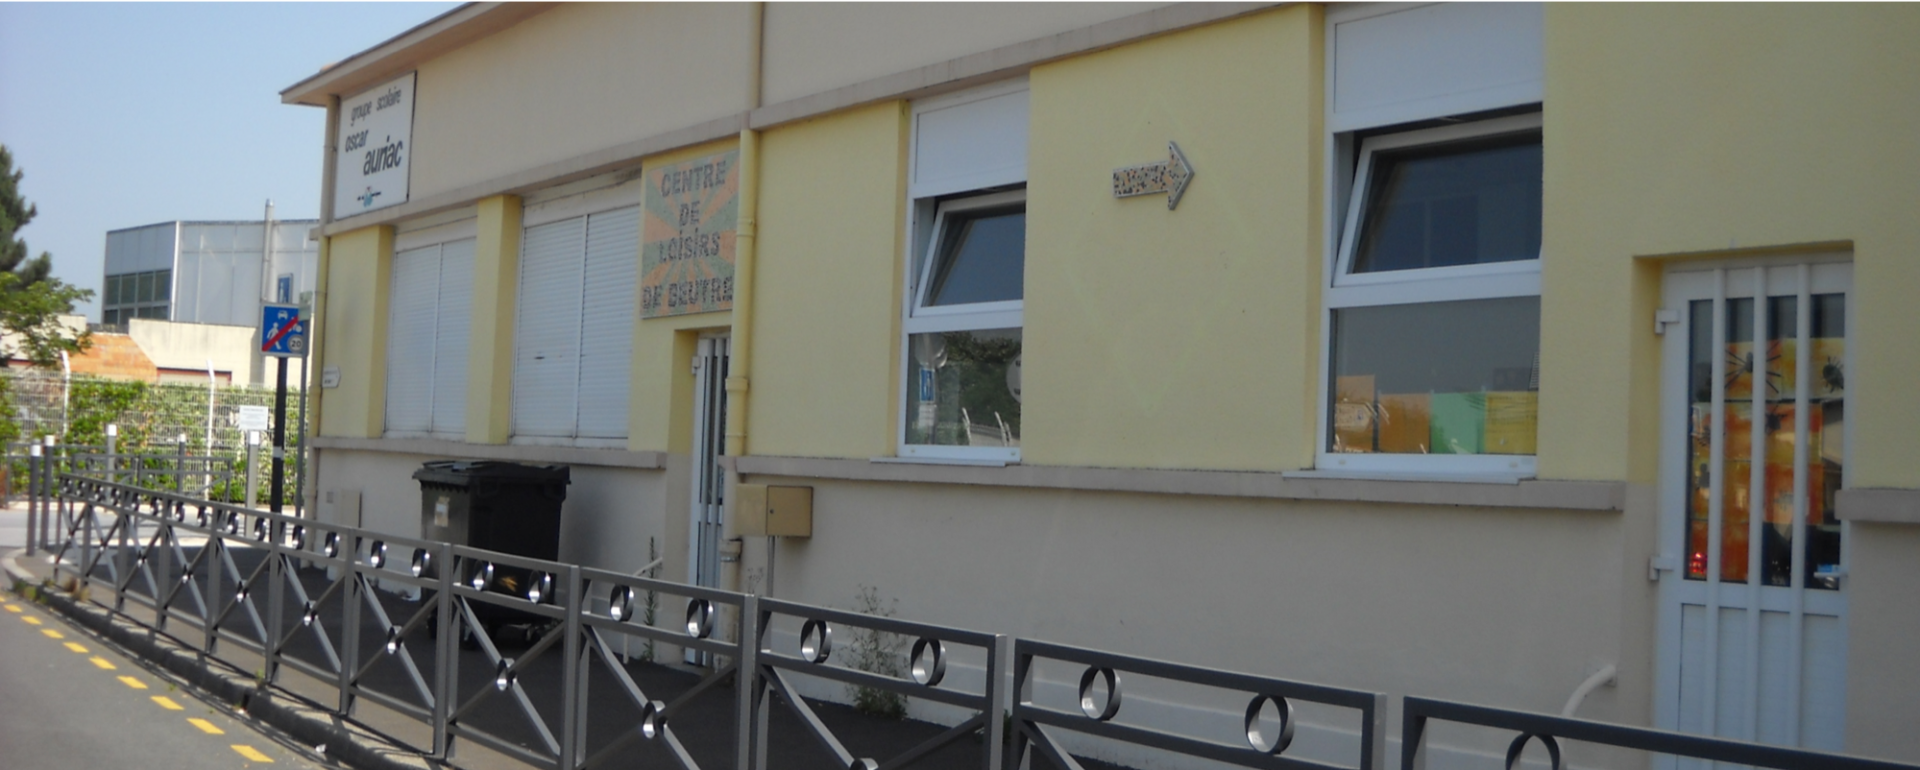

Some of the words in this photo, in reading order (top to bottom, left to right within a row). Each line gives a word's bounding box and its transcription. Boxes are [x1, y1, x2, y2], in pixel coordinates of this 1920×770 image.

[351, 101, 372, 127] groupe
[376, 86, 402, 112] scolaire
[345, 129, 369, 152] oscar
[363, 135, 403, 175] auriac
[661, 161, 727, 197] CENTRE
[679, 200, 700, 227] DE
[643, 285, 662, 309] DE
[668, 276, 733, 307] BEUTRE
[291, 339, 302, 349] 20
